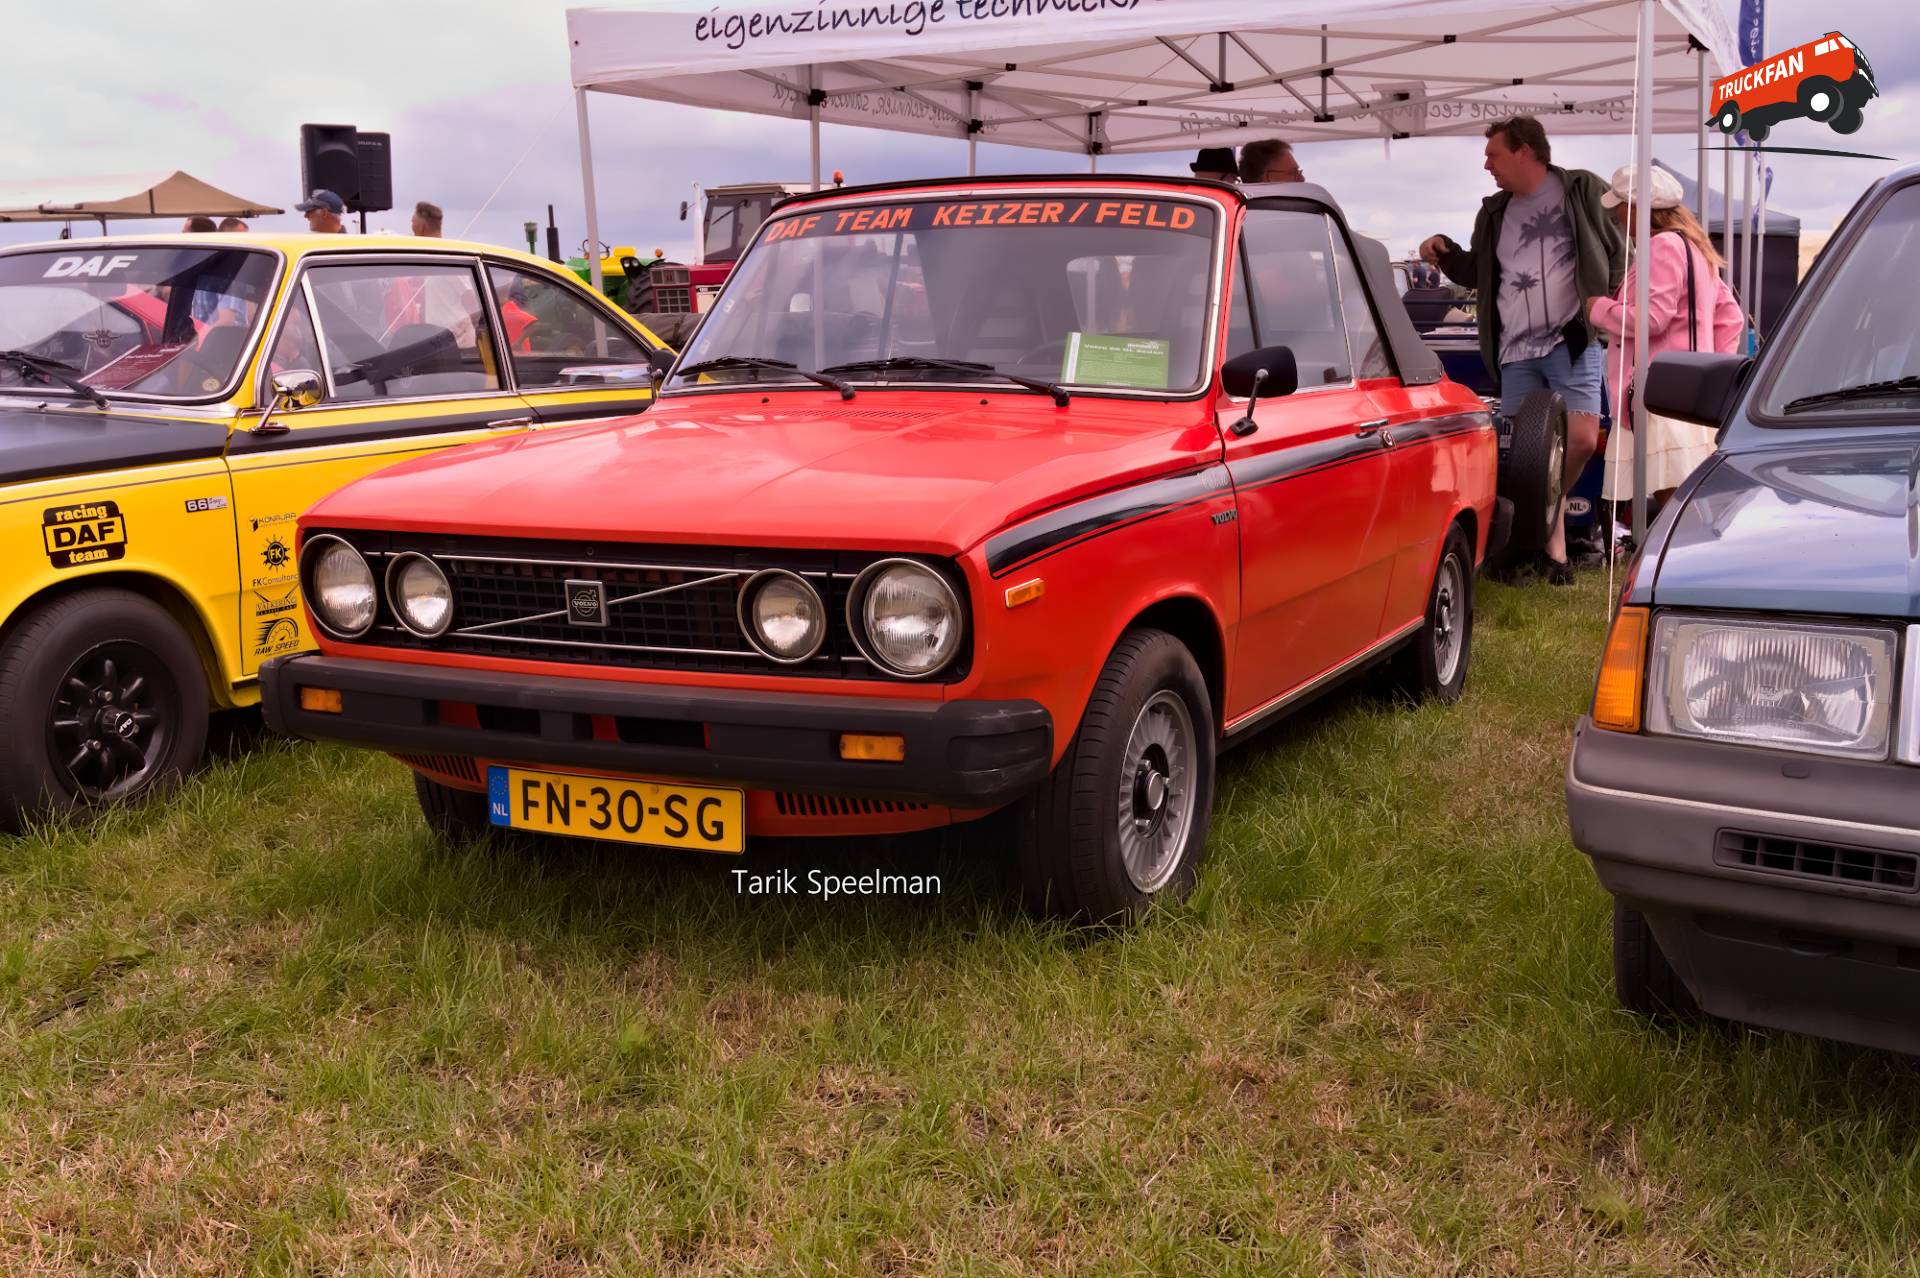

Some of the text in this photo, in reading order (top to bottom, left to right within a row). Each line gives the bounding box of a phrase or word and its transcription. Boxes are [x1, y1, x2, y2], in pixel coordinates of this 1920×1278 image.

[695, 0, 945, 50] eigenzinnige
[764, 215, 822, 244] DAF
[834, 207, 914, 233] TEAM
[42, 255, 138, 278] DAF
[55, 504, 108, 521] racing
[187, 500, 208, 511] 66
[1569, 502, 1584, 511] NL
[53, 521, 115, 549] DAF
[68, 548, 109, 564] team
[270, 547, 282, 560] FK
[254, 645, 273, 656] RAW
[275, 639, 299, 650] SPEED
[492, 778, 724, 842] NL FN-30-SG
